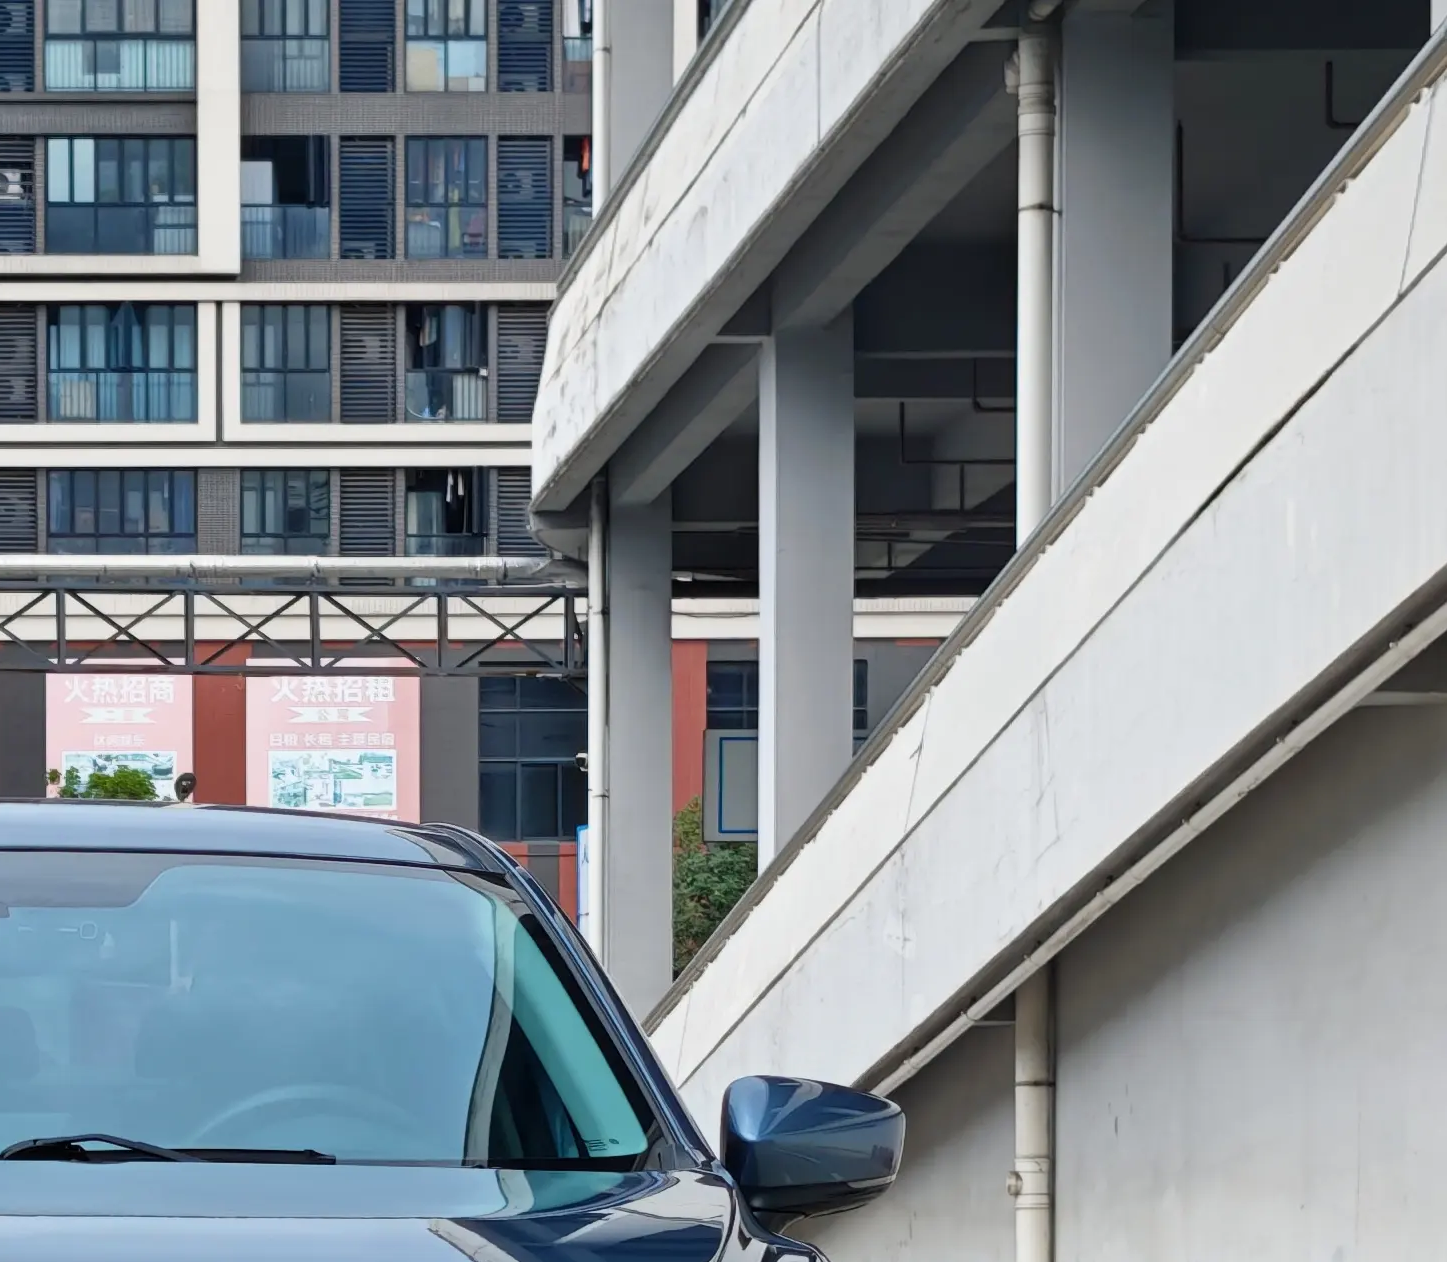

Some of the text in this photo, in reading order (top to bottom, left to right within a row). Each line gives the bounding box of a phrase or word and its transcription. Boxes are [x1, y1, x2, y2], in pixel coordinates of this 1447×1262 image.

[63, 676, 175, 704] 火热招商
[270, 676, 396, 703] 火热招租
